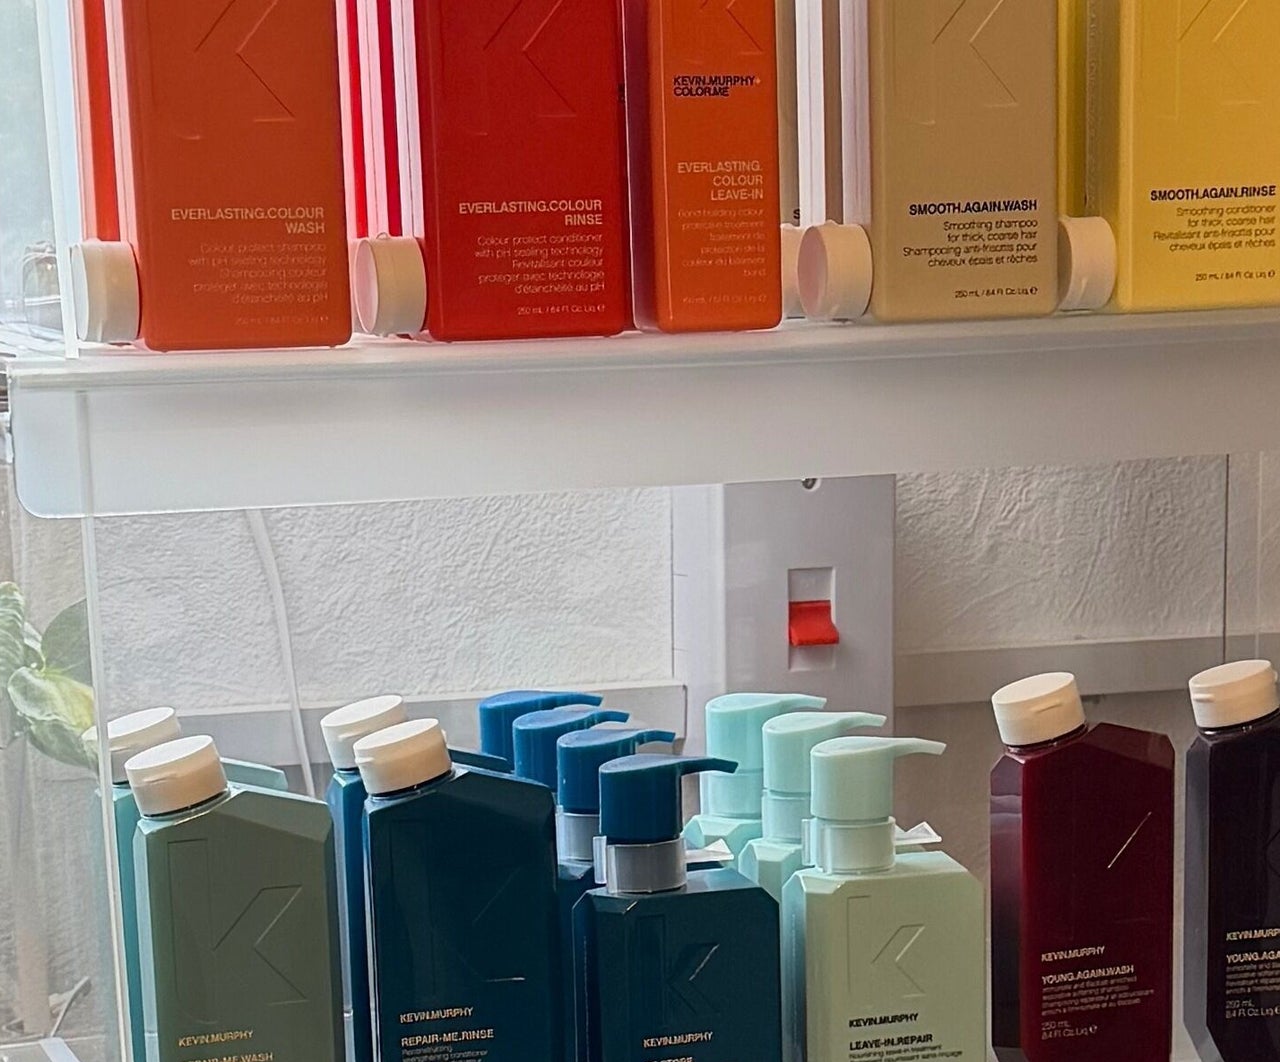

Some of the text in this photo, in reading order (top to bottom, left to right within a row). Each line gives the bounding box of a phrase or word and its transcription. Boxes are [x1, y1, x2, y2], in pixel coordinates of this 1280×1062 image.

[673, 87, 729, 97] COLOR.ME
[712, 174, 763, 186] COLOUR
[710, 188, 764, 201] LEAVE-IN
[1150, 185, 1276, 201] SMOOTH.AGAIN.RINSE
[171, 207, 325, 220] EVERLASTING.COLOUR
[459, 200, 602, 214] EVERLASTING.COLOUR
[909, 200, 1038, 216] SMOOTH.AGAIN.WASH
[1176, 205, 1276, 217] Smoothing conditioner
[564, 213, 603, 225] RINSE
[943, 219, 1038, 232] Smoothing shampoo
[285, 222, 325, 234] WASH
[477, 233, 603, 246] Colour protect conditioner
[987, 231, 1019, 241] coarse
[551, 246, 604, 256] technology
[903, 246, 961, 257] Shampooing
[928, 257, 966, 268] cheveux
[1041, 945, 1105, 962] KEVIN.MURPHY
[1041, 964, 1135, 985] YOUNG.AGAIN.WASH
[400, 1006, 474, 1023] KEVIN.MURPHY
[849, 1013, 919, 1028] KEVIN.MURPHY
[178, 1030, 254, 1047] KEVIN.MURPHY
[401, 1028, 494, 1047] REPAIR-ME.RINSE
[643, 1031, 713, 1048] KEVIN.MURPHY
[849, 1033, 933, 1051] LEAVE-IN.REPAIR
